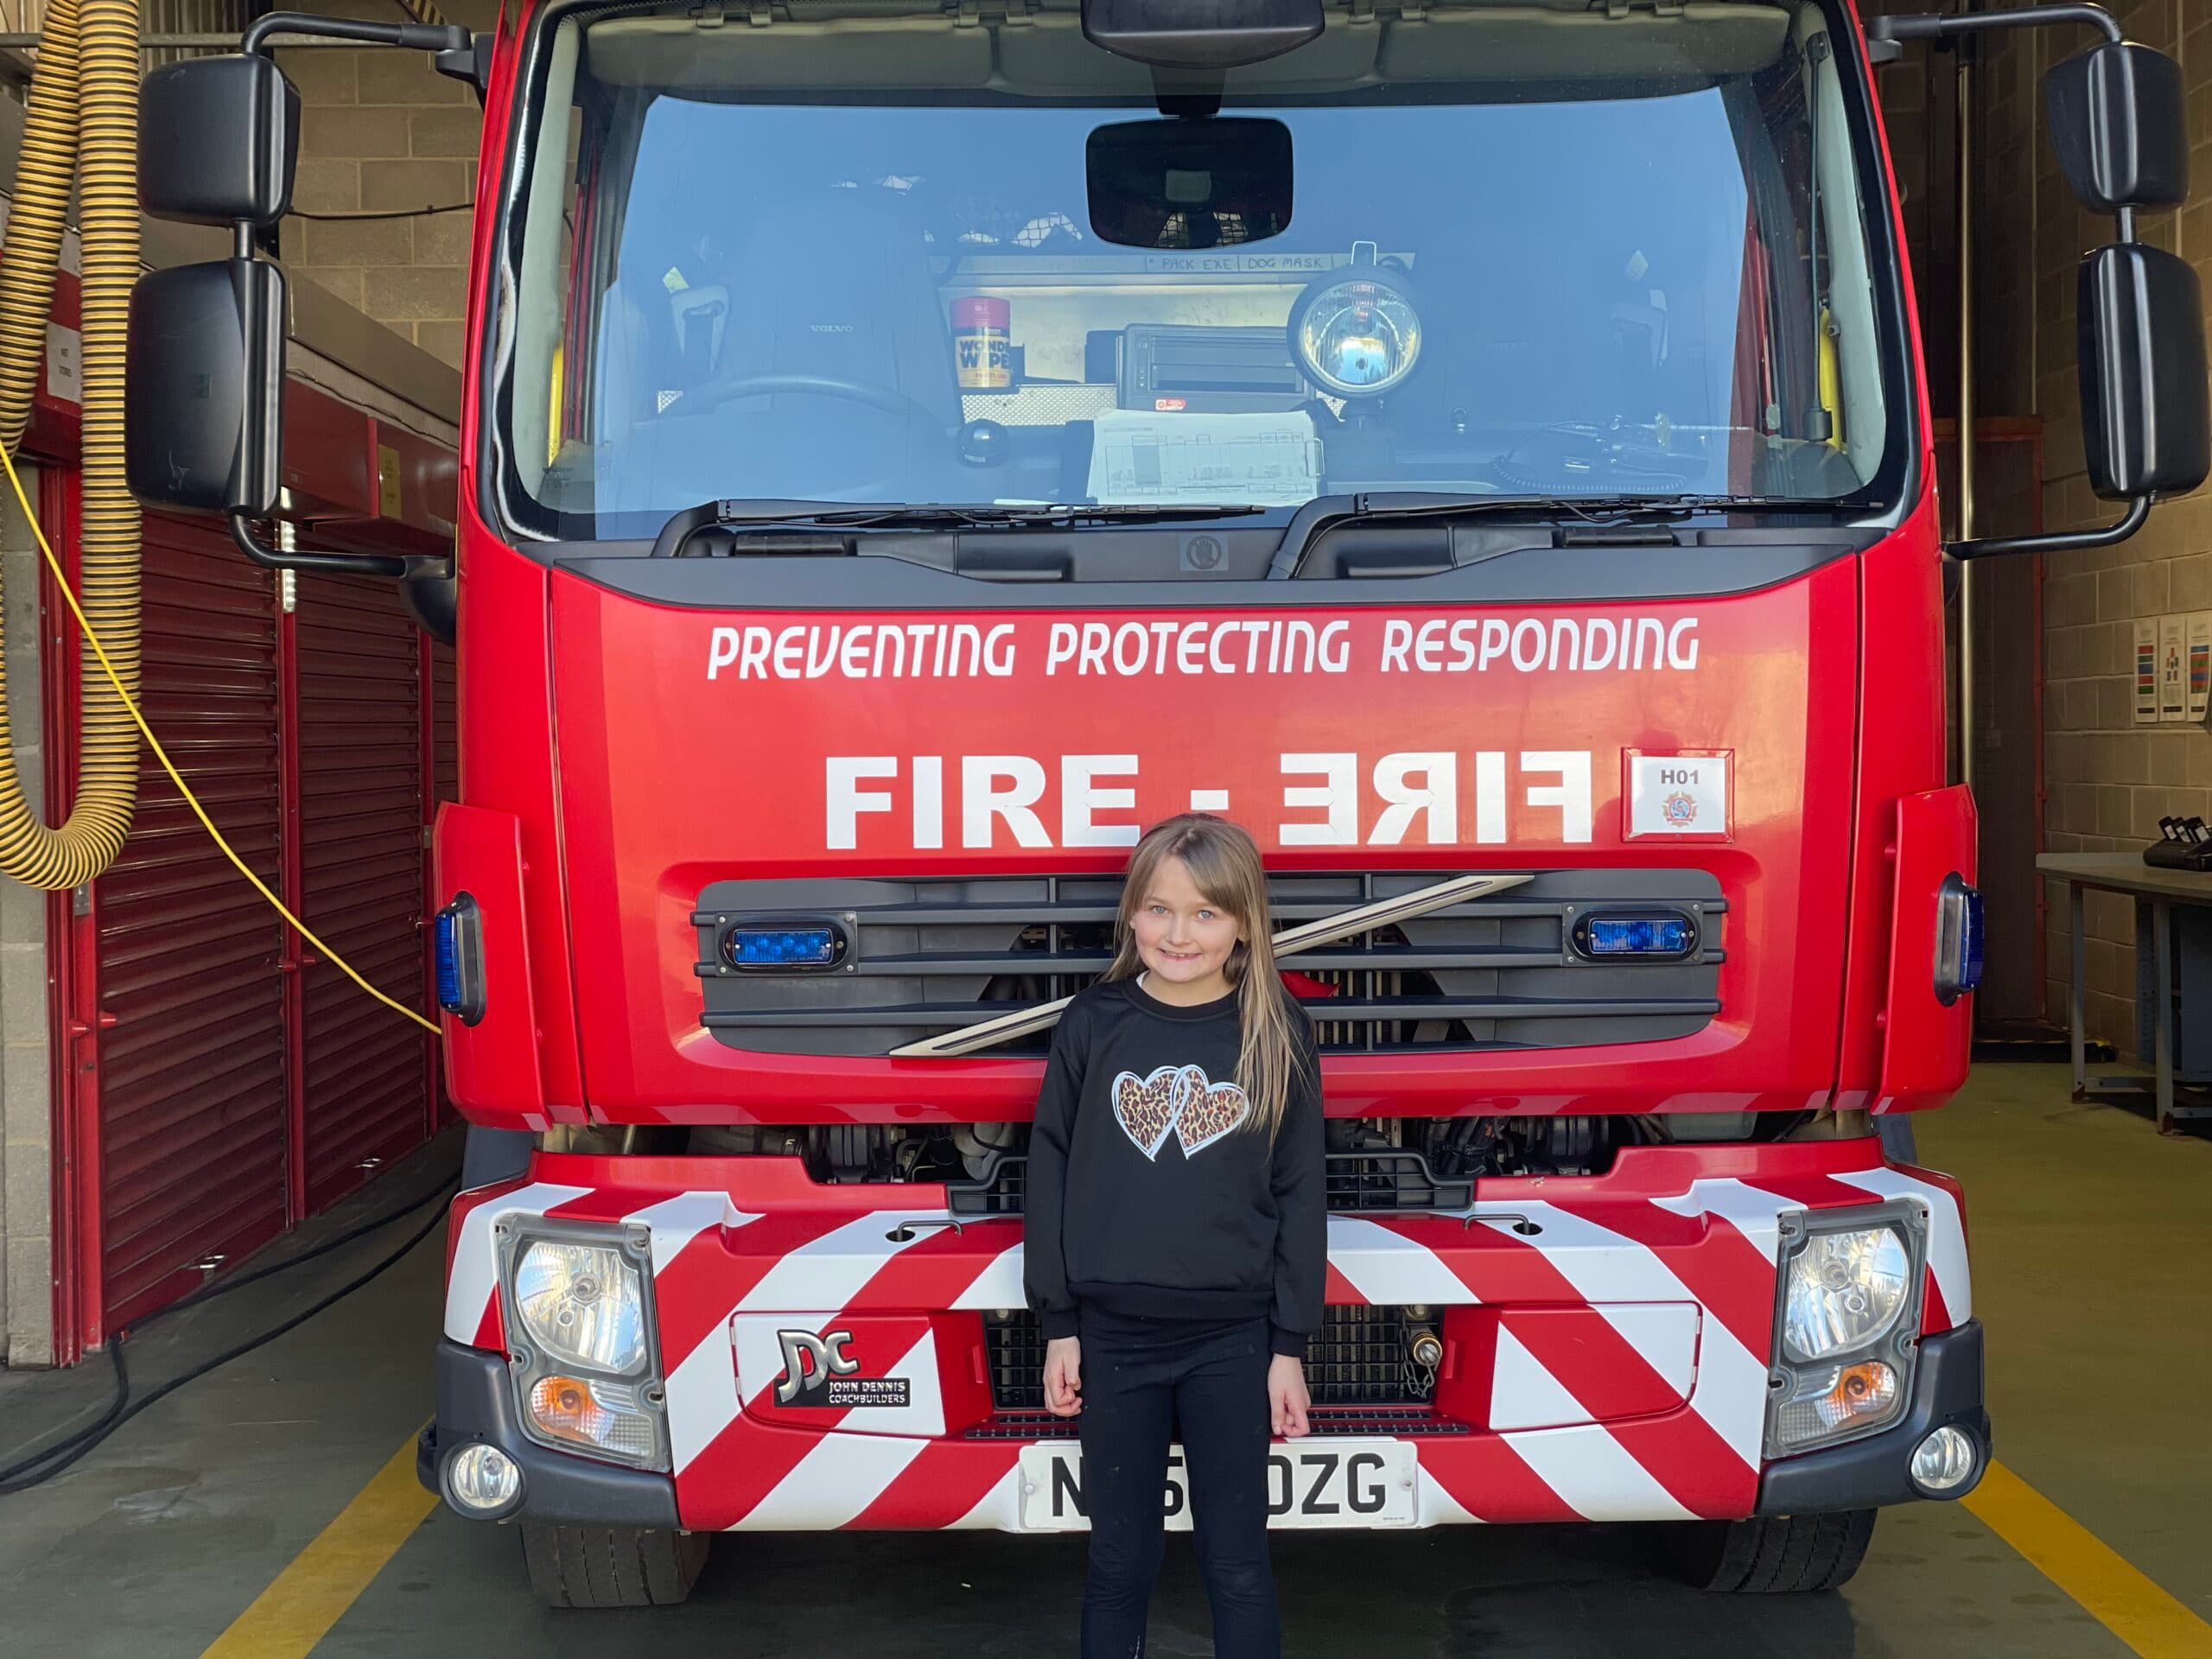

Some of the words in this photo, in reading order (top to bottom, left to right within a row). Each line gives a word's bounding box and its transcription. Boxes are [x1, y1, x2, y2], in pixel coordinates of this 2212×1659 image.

[1162, 258, 1195, 270] PACK
[1204, 258, 1232, 270] EXE
[1249, 258, 1276, 270] DOG
[1282, 257, 1324, 269] MASK
[707, 623, 1015, 680] PREVENTING
[1046, 620, 1350, 676] PROTECTING
[1380, 617, 1700, 672] RESPONDING
[1660, 769, 1699, 785] H01
[826, 754, 1141, 850] FIRE
[829, 1382, 859, 1394] JOHN
[861, 1382, 906, 1392] DENNIS
[829, 1394, 906, 1404] COACHBUILDERS
